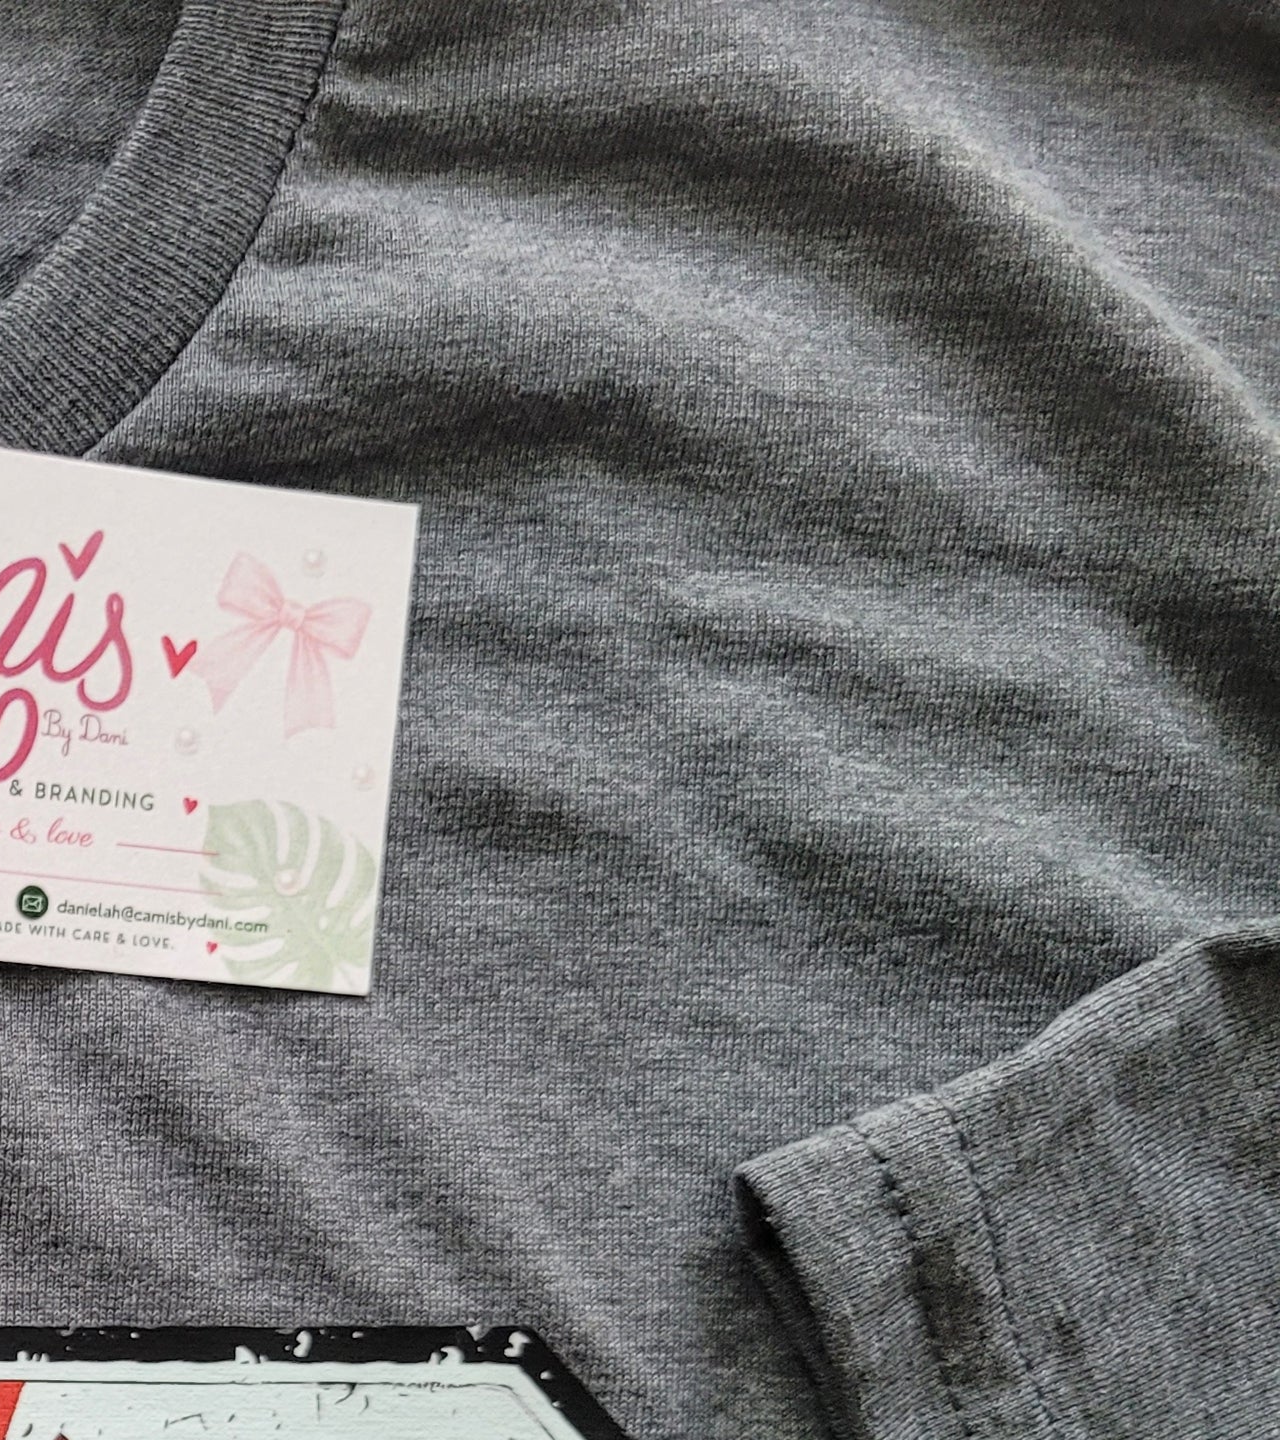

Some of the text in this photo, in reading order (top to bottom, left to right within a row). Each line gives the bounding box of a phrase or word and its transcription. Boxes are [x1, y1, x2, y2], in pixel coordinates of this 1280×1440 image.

[41, 708, 129, 756] By Dani
[8, 779, 24, 796] &
[35, 783, 156, 812] BRANDING
[46, 817, 94, 848] love
[56, 899, 269, 934] danielah@camisbydani.com
[28, 923, 67, 940] WITH
[72, 928, 110, 945] CARE
[132, 934, 175, 950] LOVE.
